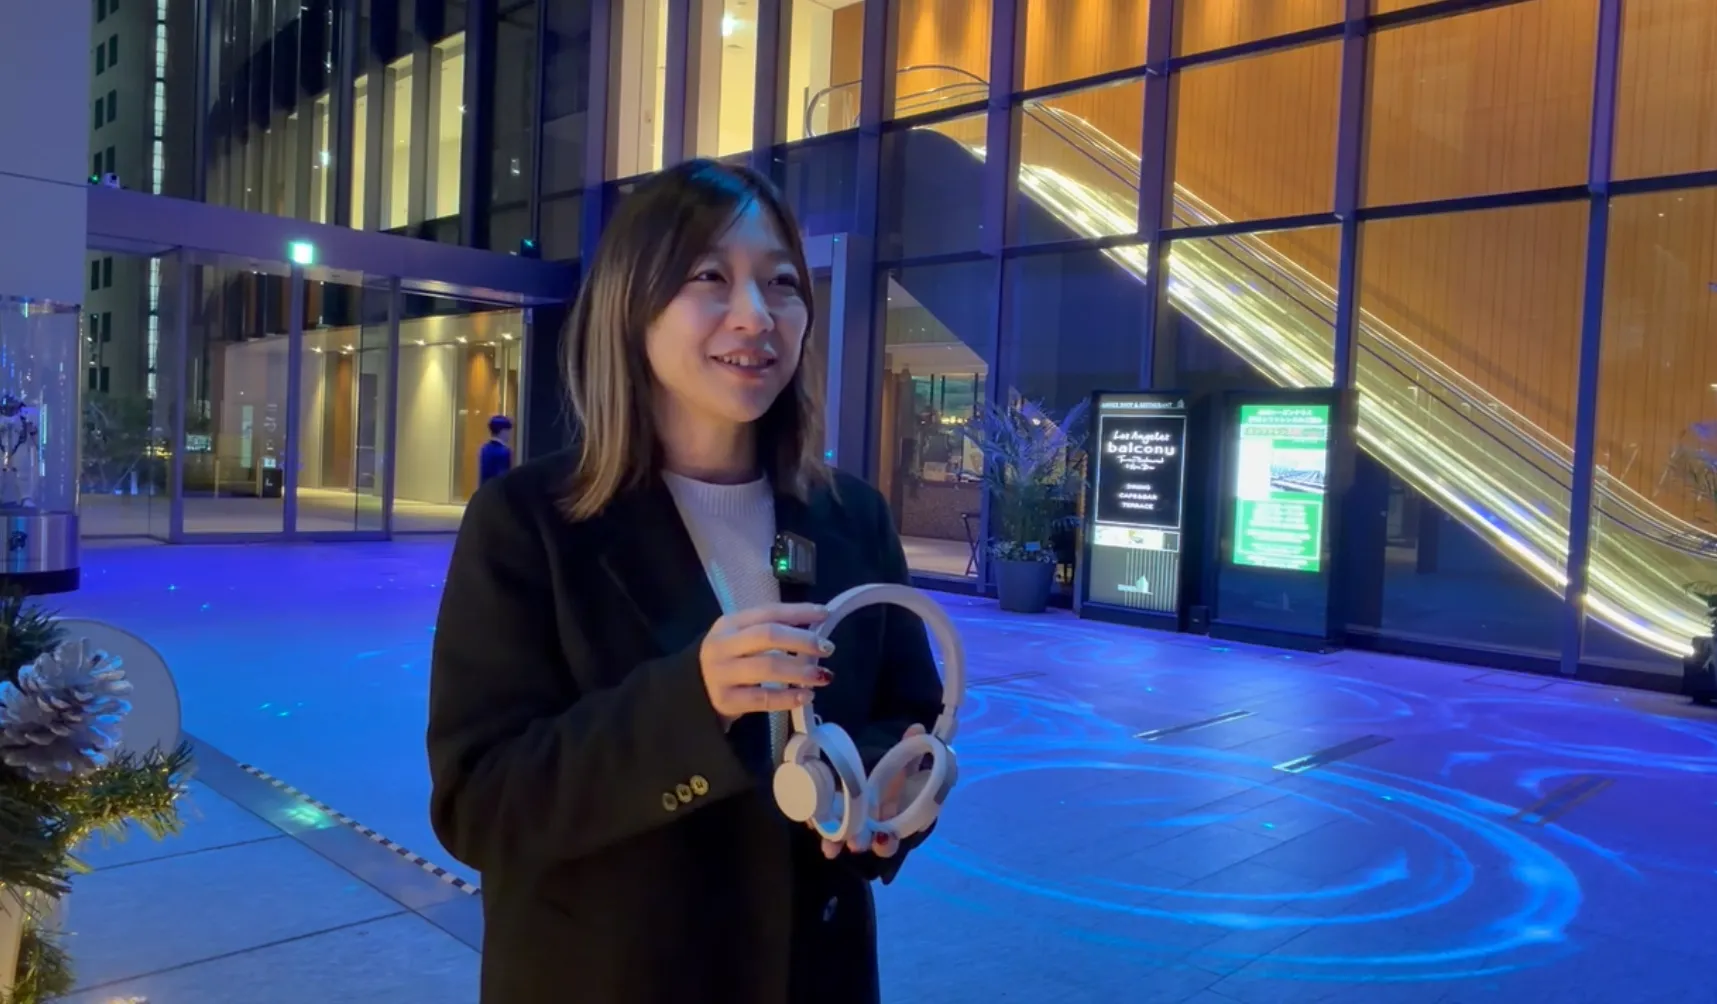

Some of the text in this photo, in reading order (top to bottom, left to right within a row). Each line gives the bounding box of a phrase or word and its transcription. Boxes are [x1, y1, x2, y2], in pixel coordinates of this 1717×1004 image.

[1113, 430, 1170, 445] Los Angeles
[1107, 441, 1175, 456] balcony
